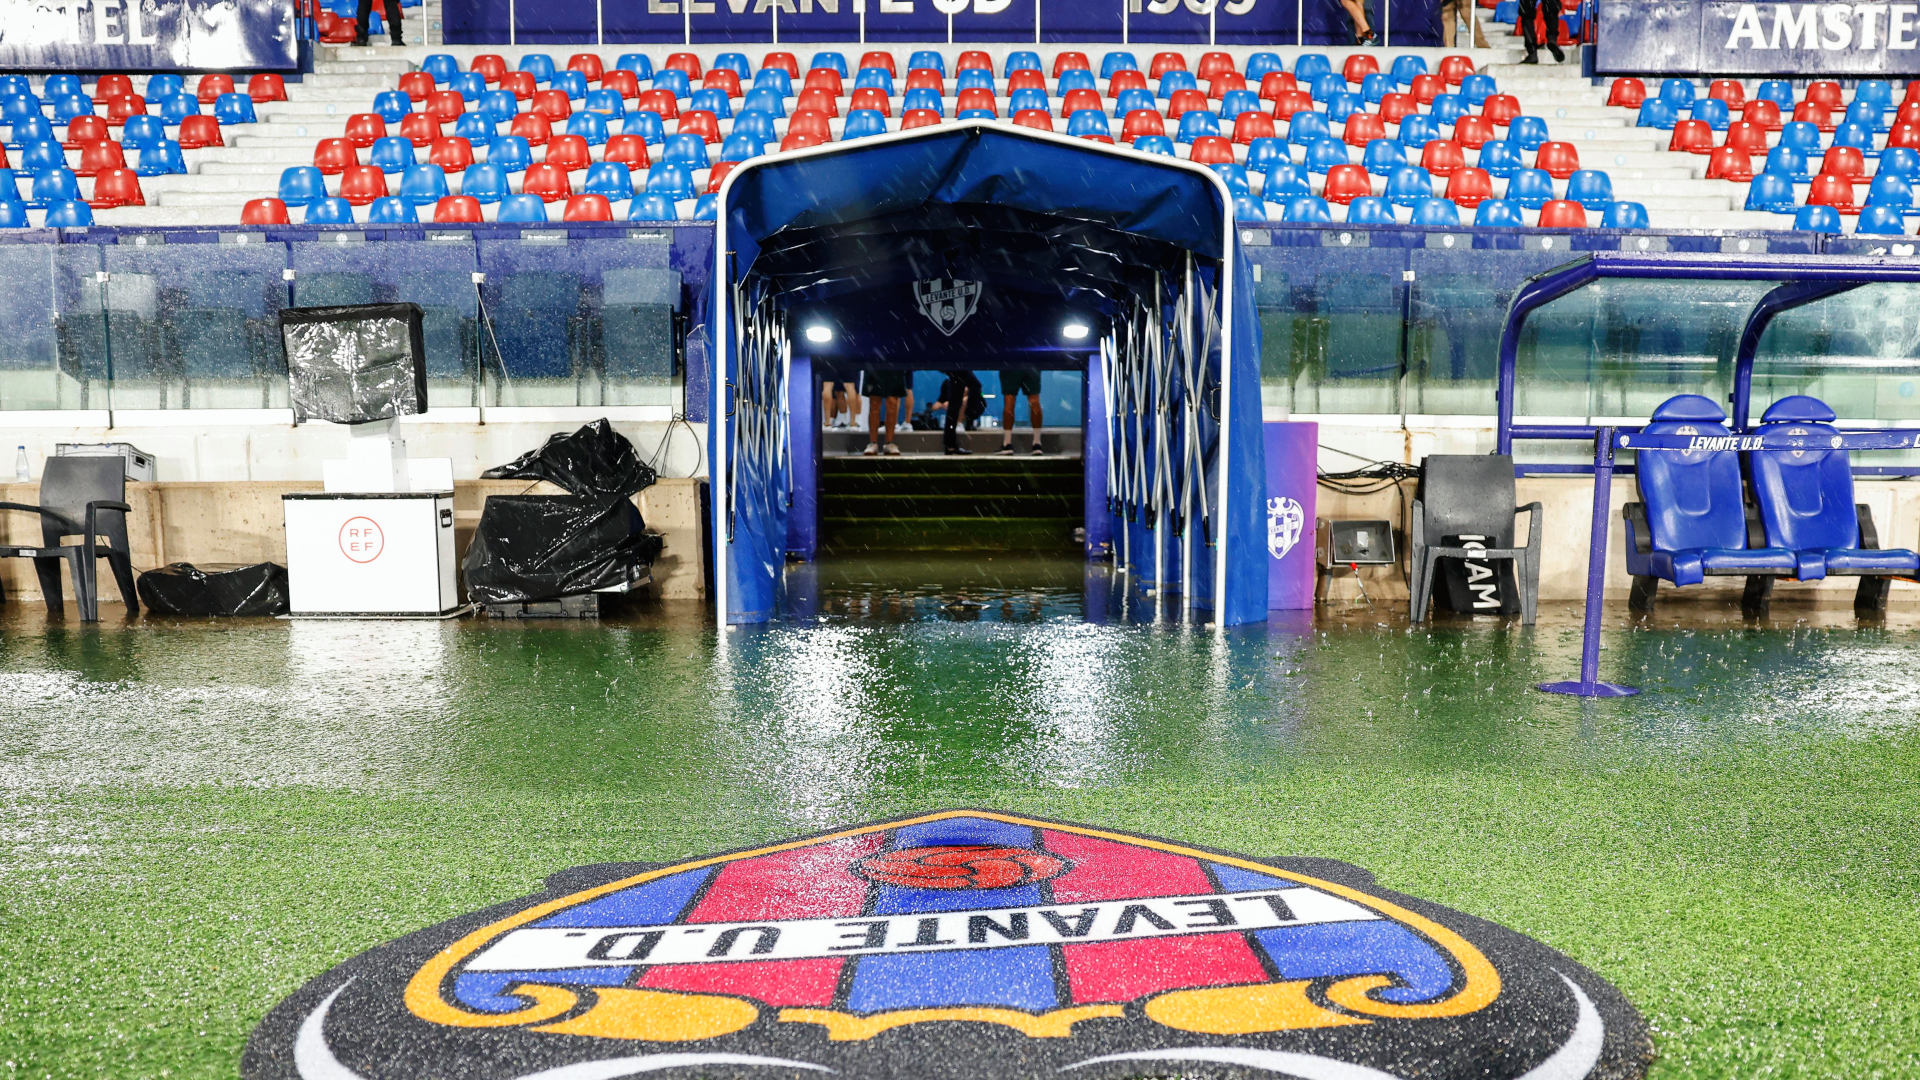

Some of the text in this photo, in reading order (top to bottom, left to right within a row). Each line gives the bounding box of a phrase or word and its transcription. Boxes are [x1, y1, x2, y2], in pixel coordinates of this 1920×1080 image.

[0, 0, 159, 45] TEL
[1724, 3, 1919, 50] AMSTE
[926, 289, 955, 303] LEVANTE
[1689, 436, 1765, 450] LEVANTE U.D.
[564, 894, 1299, 961] LEVANTE U.D.
